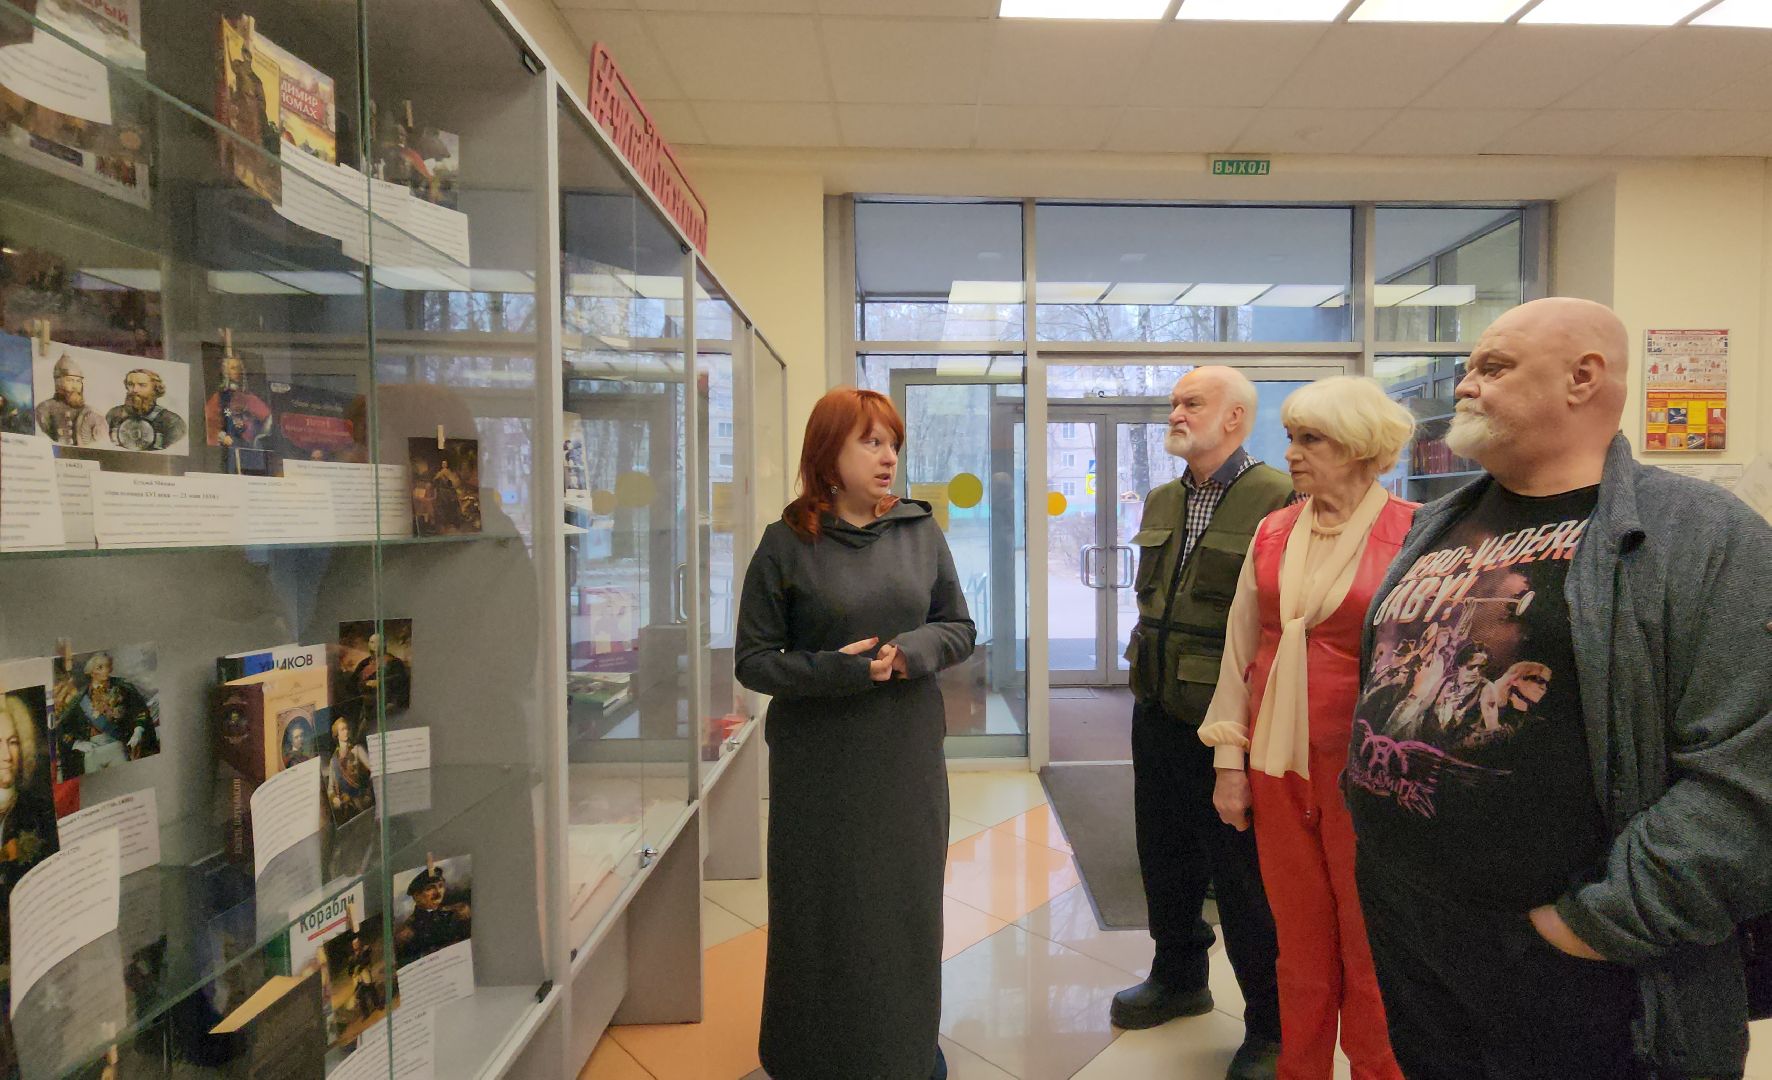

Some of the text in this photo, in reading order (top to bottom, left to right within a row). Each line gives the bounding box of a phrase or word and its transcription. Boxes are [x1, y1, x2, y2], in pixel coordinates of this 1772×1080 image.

[1214, 161, 1268, 175] ВЫХОД
[1373, 570, 1479, 626] BABY!
[300, 894, 354, 933] Корабли
